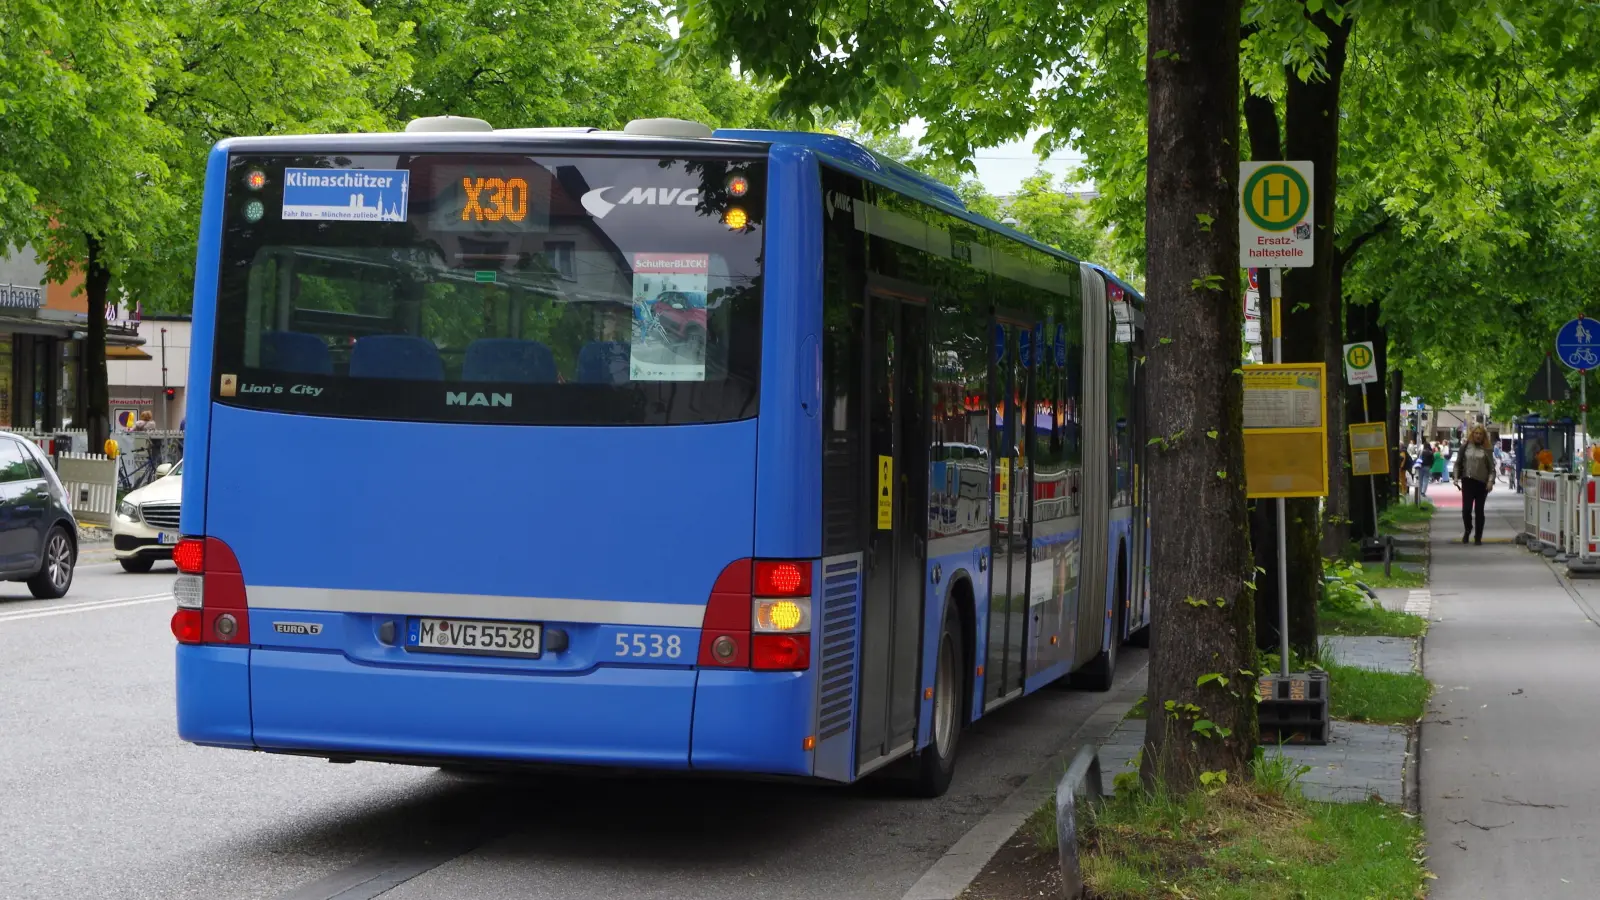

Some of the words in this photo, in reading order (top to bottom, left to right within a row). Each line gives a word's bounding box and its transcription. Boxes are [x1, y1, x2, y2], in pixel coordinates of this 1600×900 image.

[286, 172, 393, 188] Klimaschützer
[462, 177, 528, 221] X30
[617, 187, 699, 206] MVG
[834, 192, 852, 212] MVG
[1263, 179, 1289, 216] H
[1257, 236, 1295, 245] Ersatz-
[1249, 248, 1304, 257] haltestelle
[635, 259, 707, 269] SchulterBLICK!
[1354, 349, 1366, 365] H
[240, 383, 284, 394] Lion's
[289, 384, 324, 397] City
[446, 391, 513, 407] MAN
[277, 624, 305, 634] EURO
[310, 624, 319, 634] 6
[420, 621, 435, 643] M
[615, 632, 682, 658] 5538
